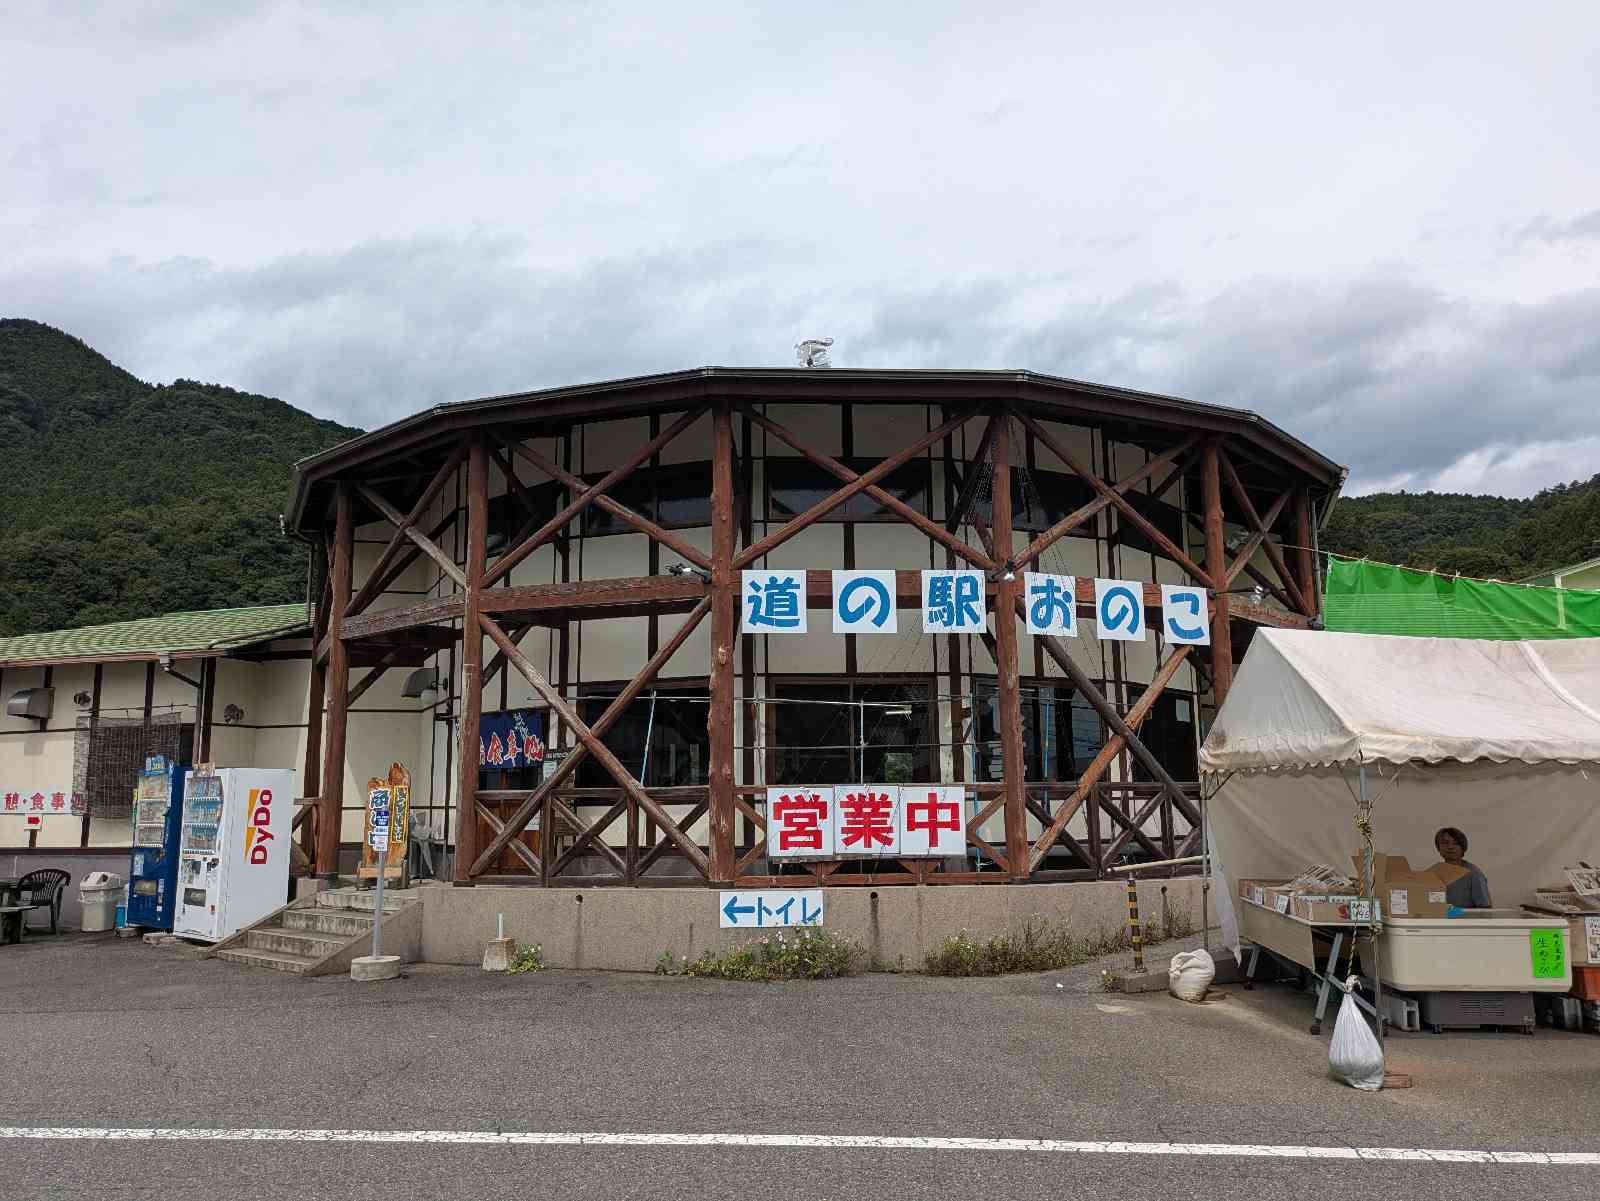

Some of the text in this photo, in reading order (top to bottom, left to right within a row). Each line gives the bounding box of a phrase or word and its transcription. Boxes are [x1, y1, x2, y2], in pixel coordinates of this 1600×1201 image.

[748, 575, 1205, 641] 道の駅 おのこ
[250, 788, 275, 865] DyDo
[772, 792, 961, 851] 営業中
[757, 896, 822, 926] トイレ
